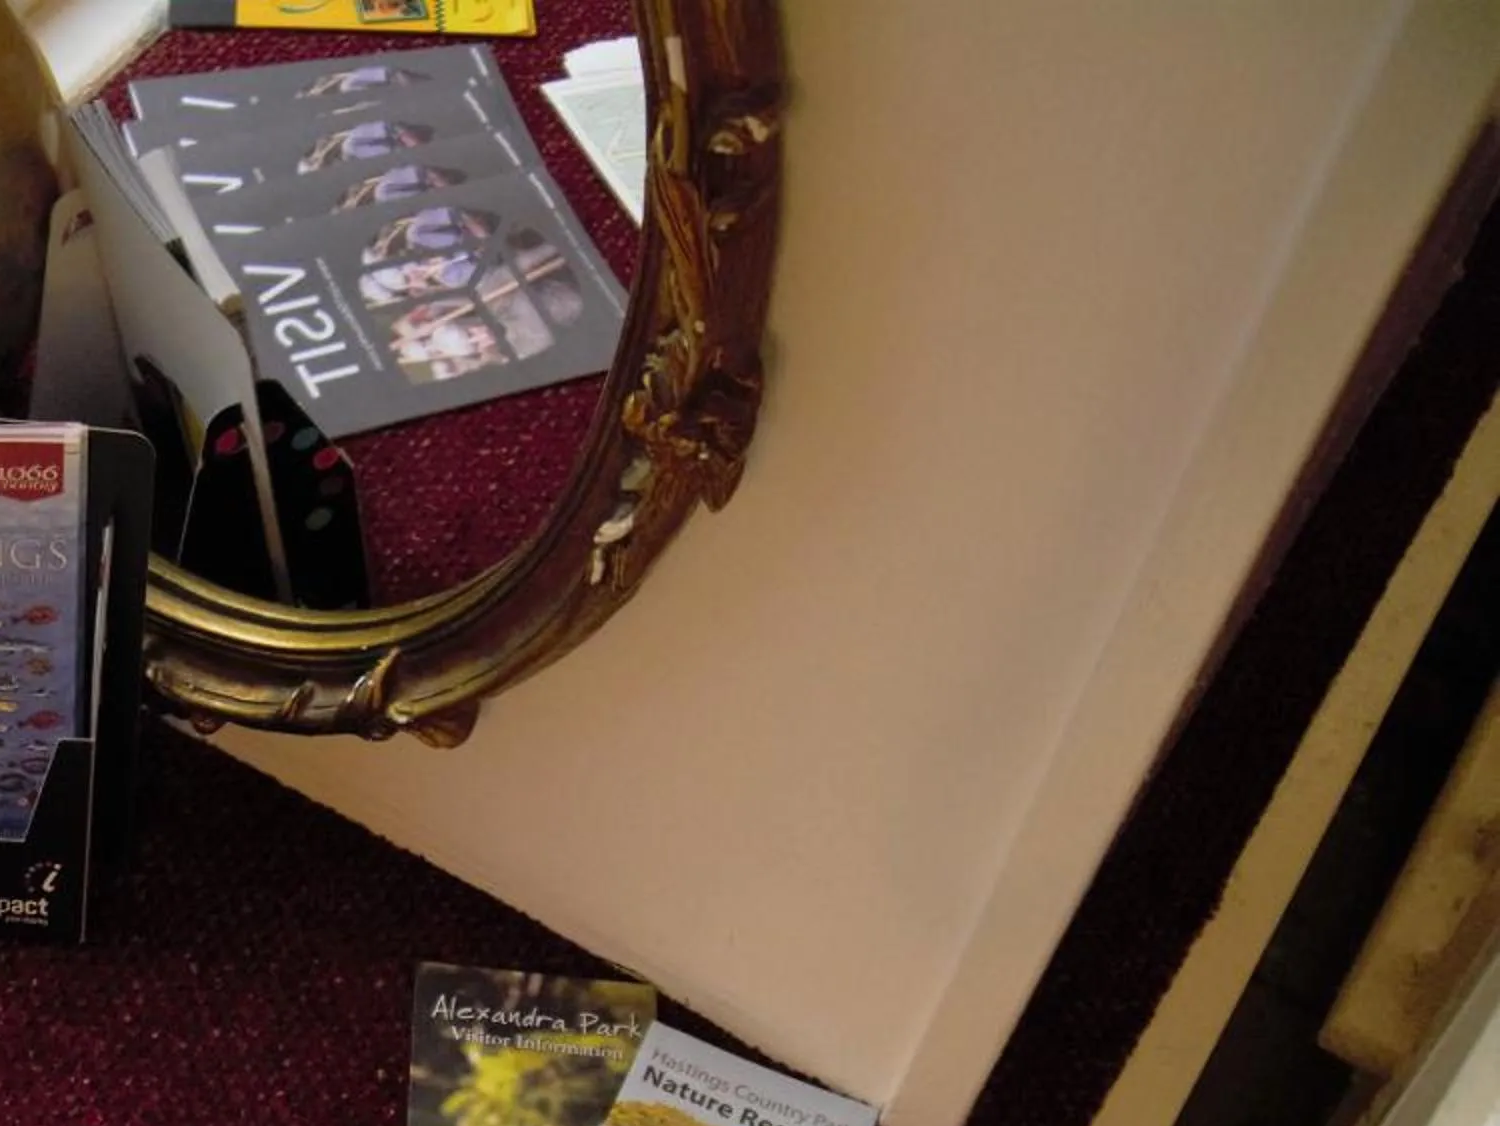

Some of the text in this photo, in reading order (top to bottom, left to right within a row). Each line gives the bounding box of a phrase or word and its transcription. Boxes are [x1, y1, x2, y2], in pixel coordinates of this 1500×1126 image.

[431, 993, 643, 1039] Alexandra Park
[450, 1025, 624, 1061] Visitor Information
[642, 1065, 734, 1120] Nature
[651, 1047, 730, 1094] Hastings
[733, 1083, 812, 1125] Country
